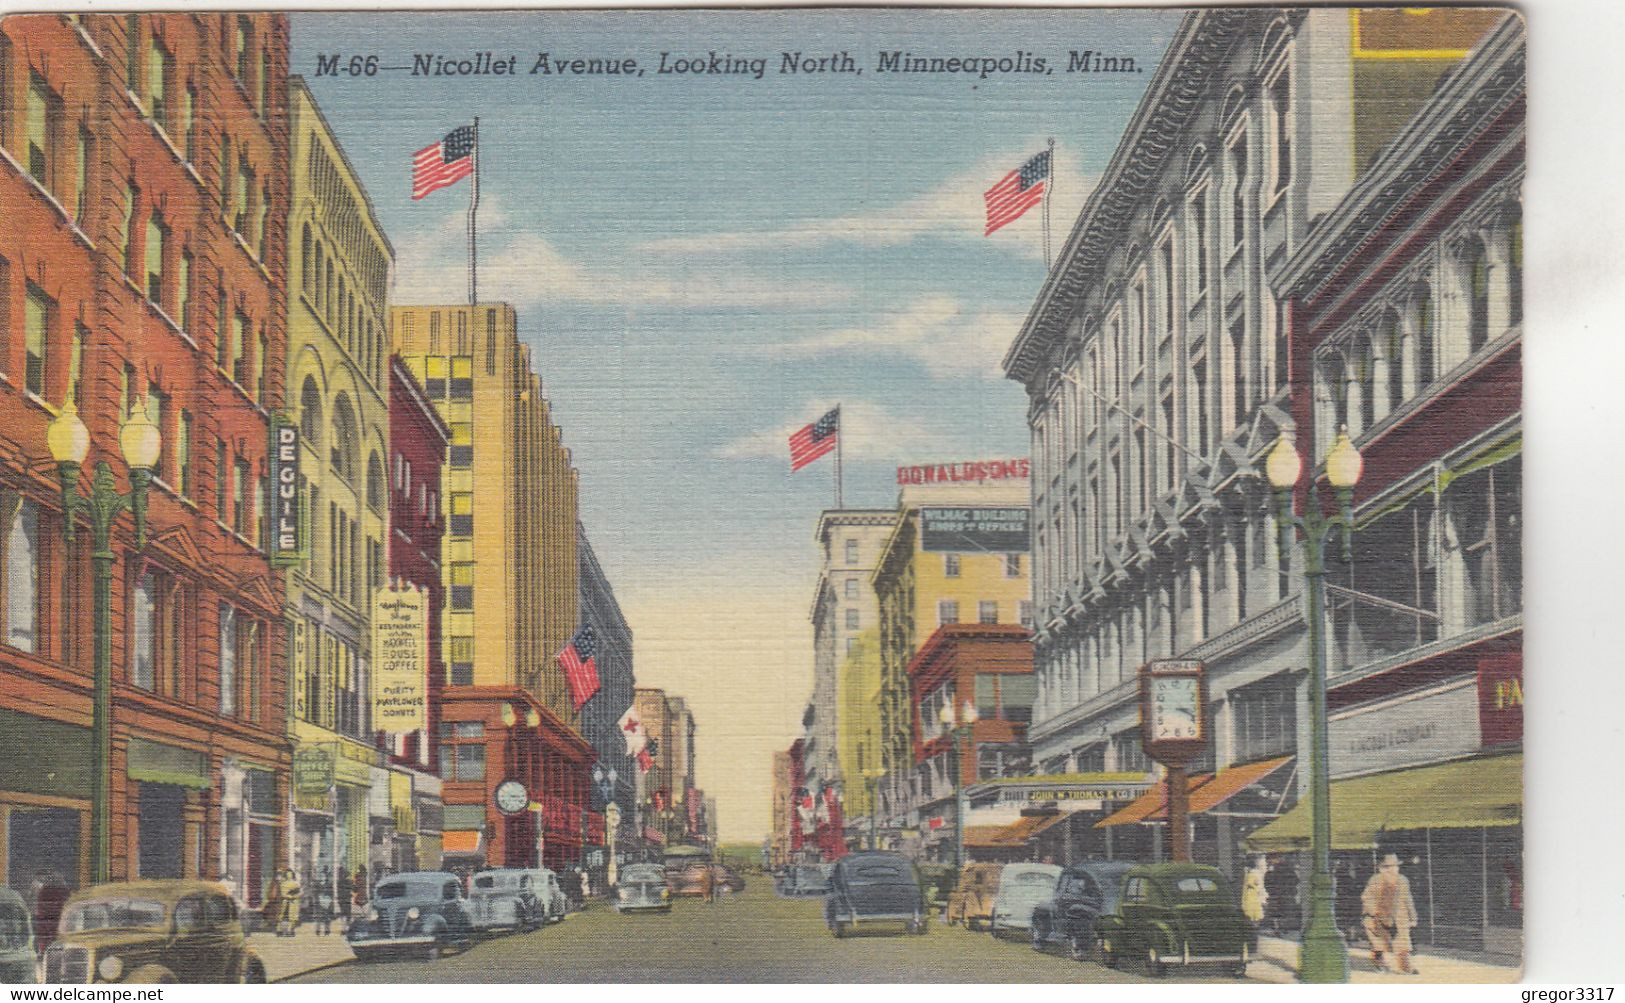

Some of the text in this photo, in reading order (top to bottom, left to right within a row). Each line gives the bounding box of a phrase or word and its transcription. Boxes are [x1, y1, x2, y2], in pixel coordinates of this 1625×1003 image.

[972, 509, 1027, 521] BUILDING
[383, 650, 418, 660] HOUSE
[296, 622, 304, 713] SUITS
[383, 660, 418, 671] COFFEE
[383, 686, 415, 695] PURITY
[382, 708, 416, 718] DONUTS
[1028, 790, 1054, 800] JOHN
[1067, 789, 1105, 799] THOMAS
